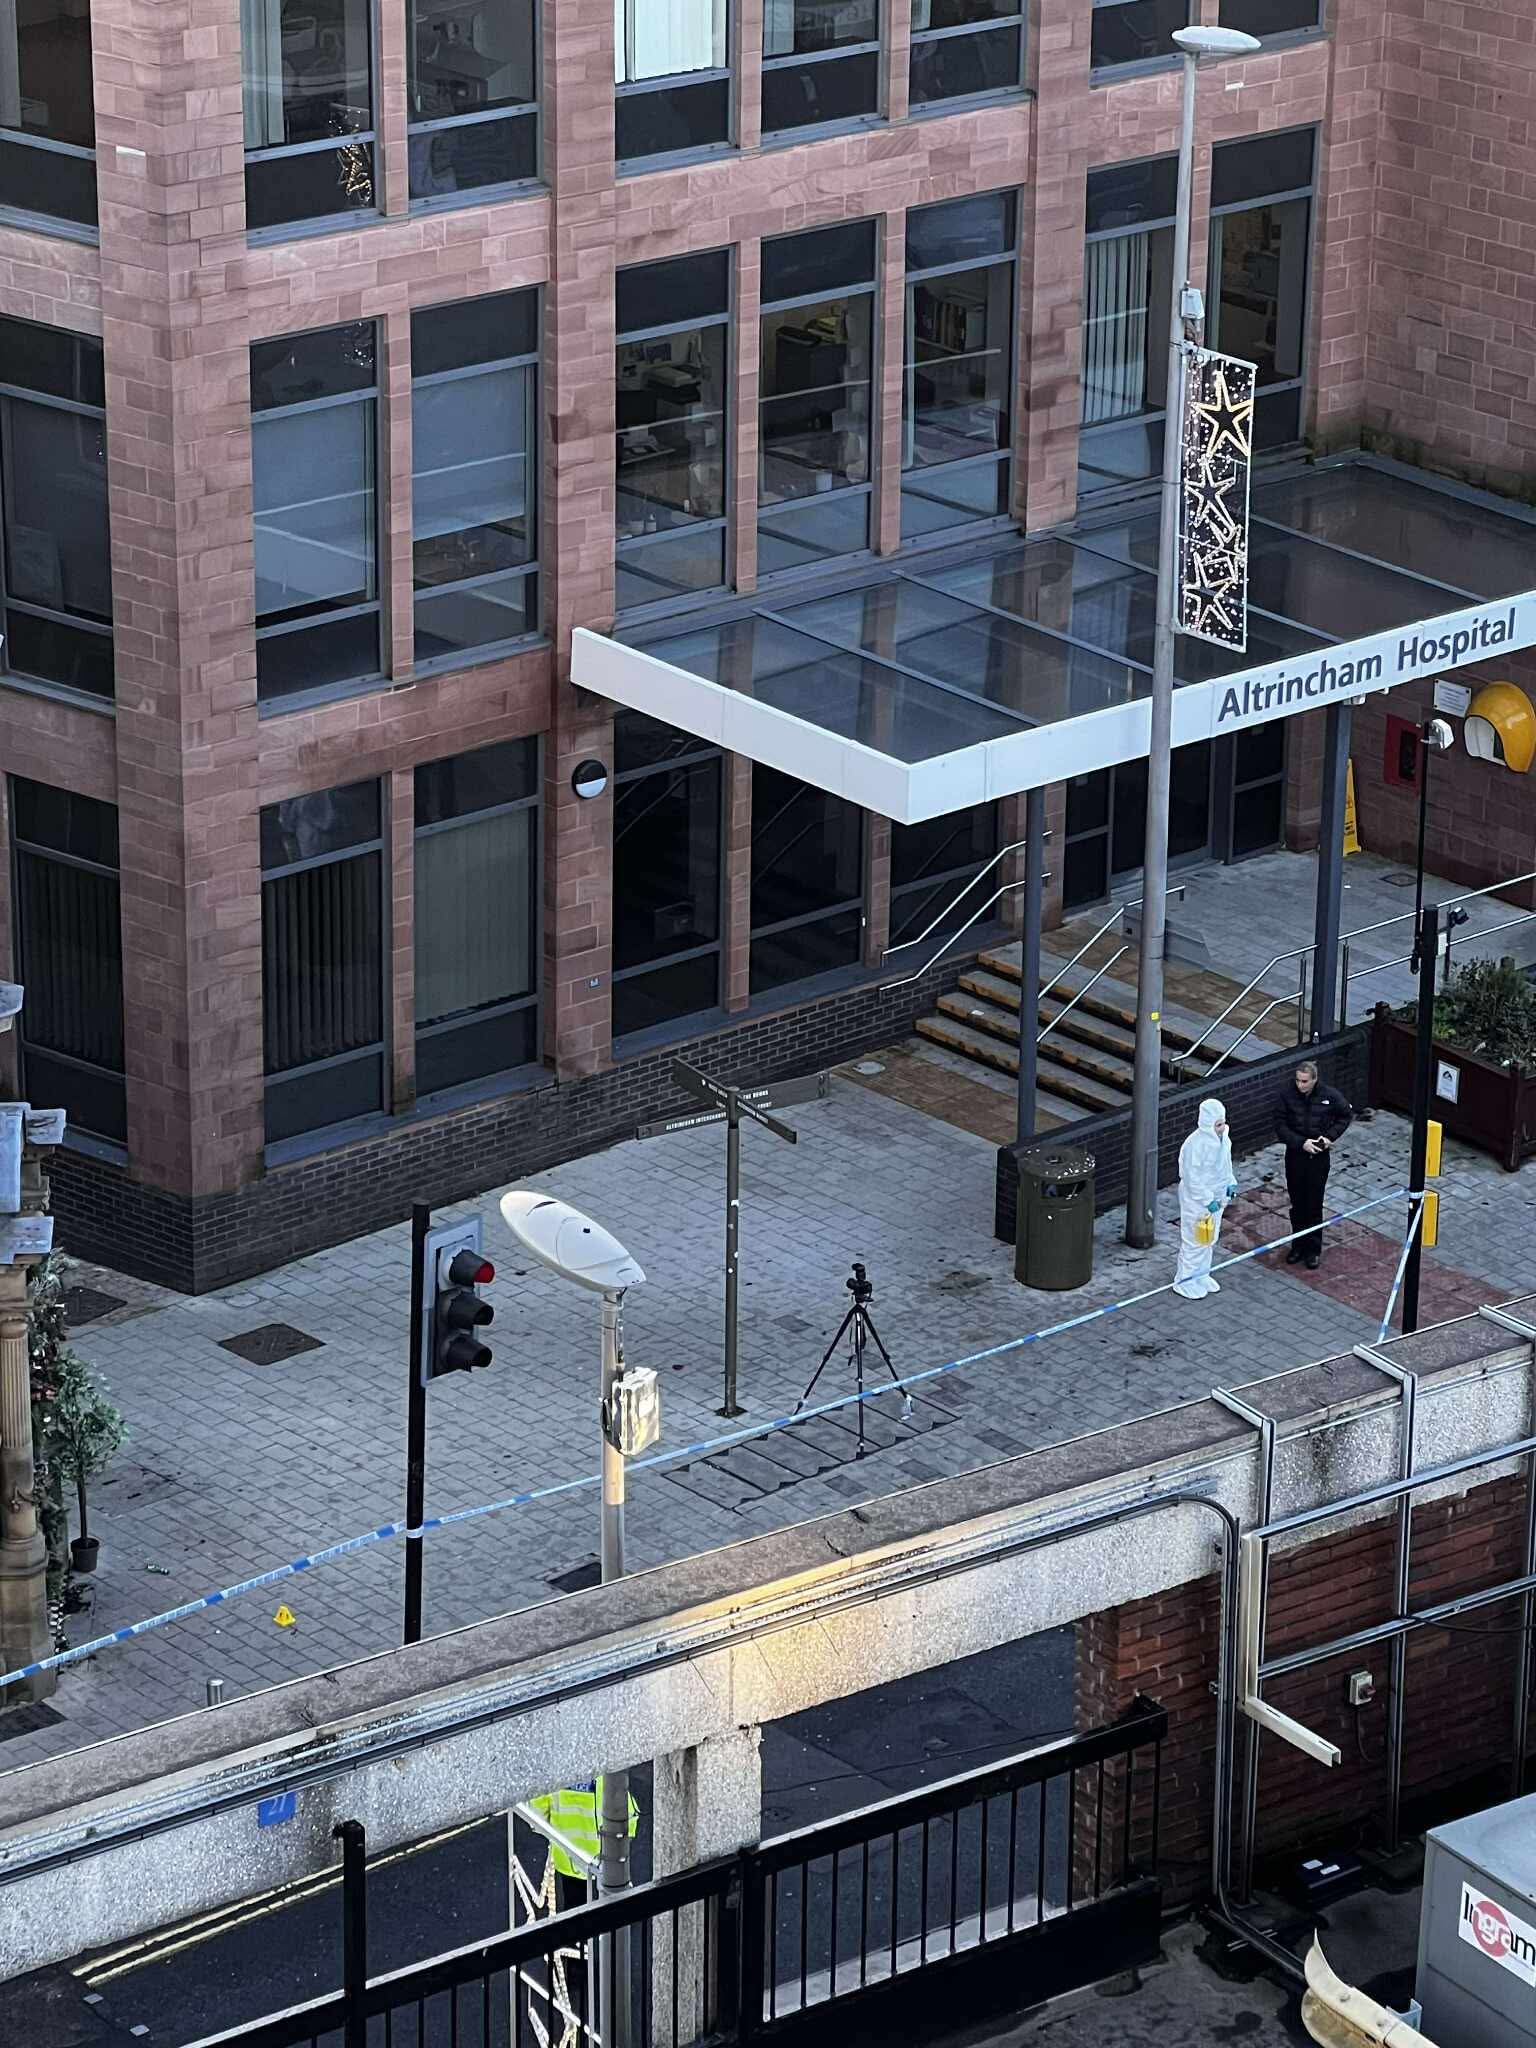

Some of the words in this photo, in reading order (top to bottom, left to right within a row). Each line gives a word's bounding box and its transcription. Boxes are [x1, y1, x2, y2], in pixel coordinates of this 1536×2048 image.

[1217, 654, 1382, 722] Altrincham
[1397, 607, 1516, 671] Hospital
[1463, 1890, 1536, 1967] Ingram
